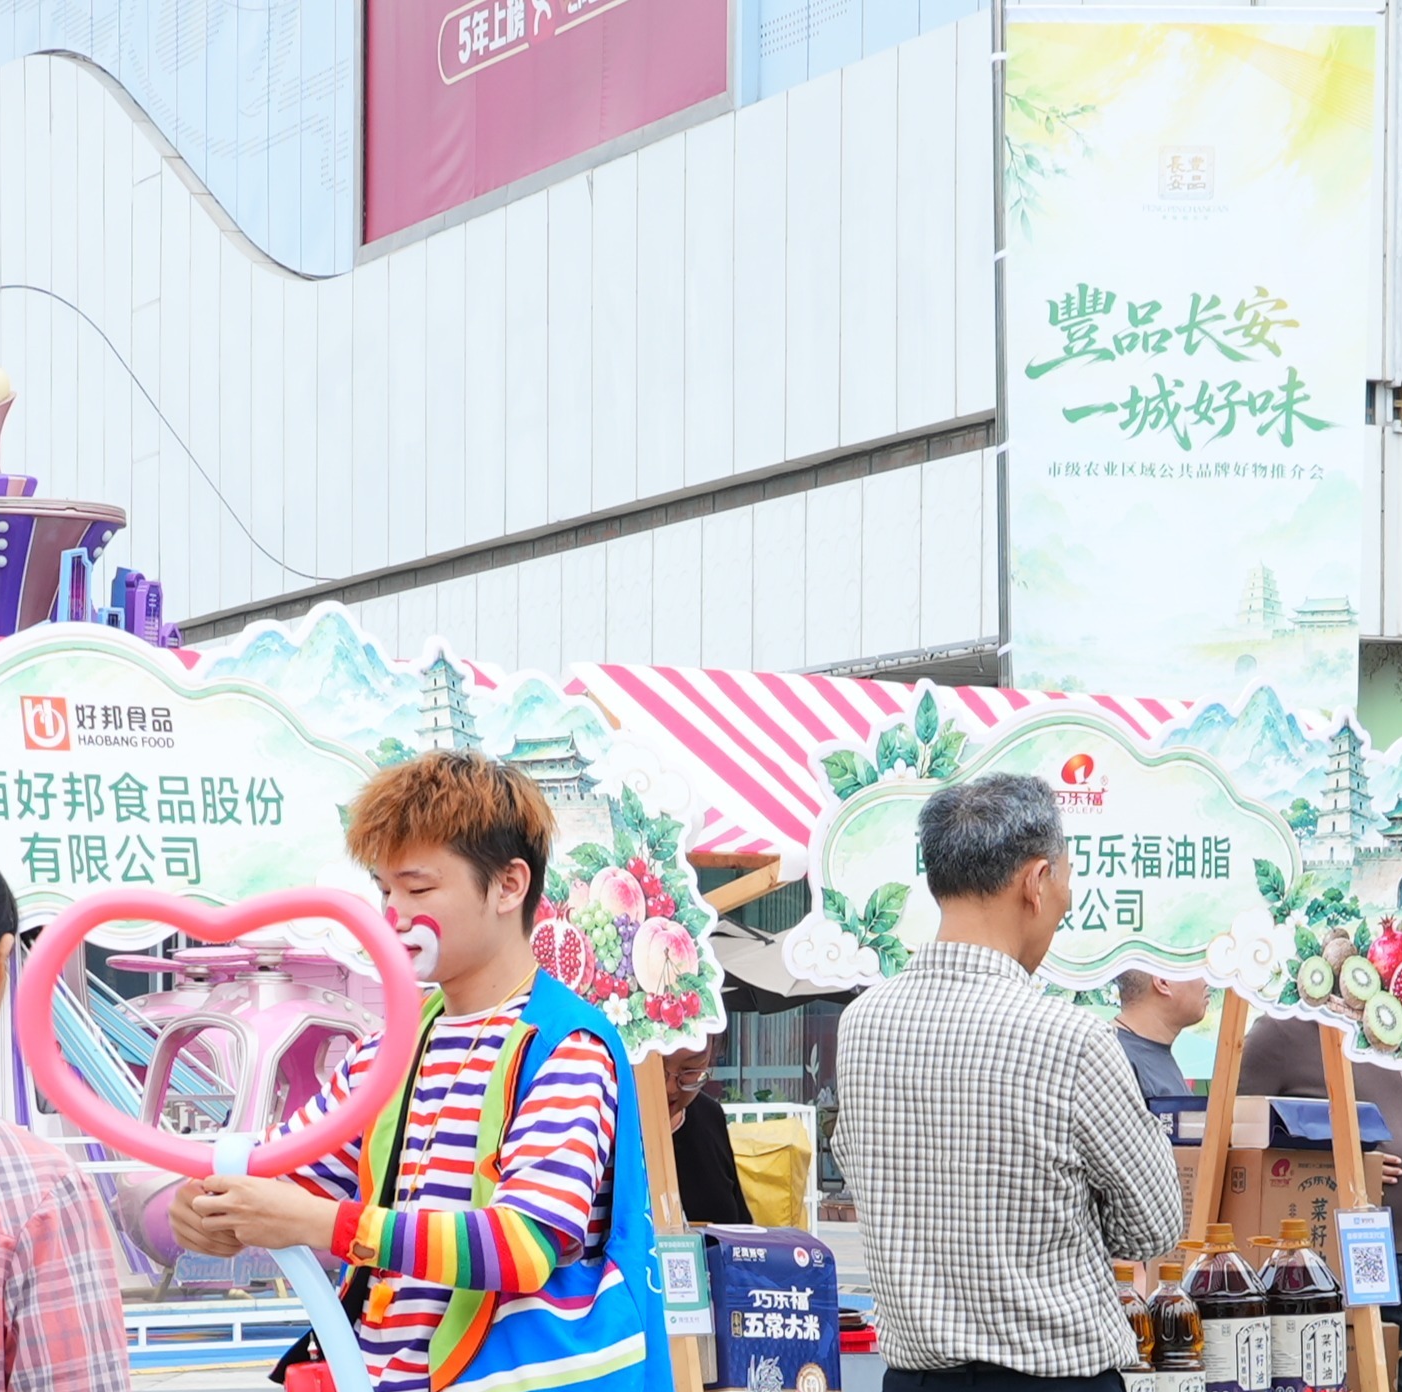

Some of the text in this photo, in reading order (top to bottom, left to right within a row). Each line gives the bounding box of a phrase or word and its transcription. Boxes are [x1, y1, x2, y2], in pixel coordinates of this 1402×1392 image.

[1063, 367, 1347, 451] 一城好味
[1047, 461, 1326, 482] 市级农业区域公共品牌好物推介会
[75, 704, 173, 733] 好邦食品
[78, 734, 175, 749] HAOBANG FOOD
[20, 832, 201, 884] 有限公司
[748, 1285, 814, 1311] 巧乐福
[743, 1312, 821, 1341] 五常大米
